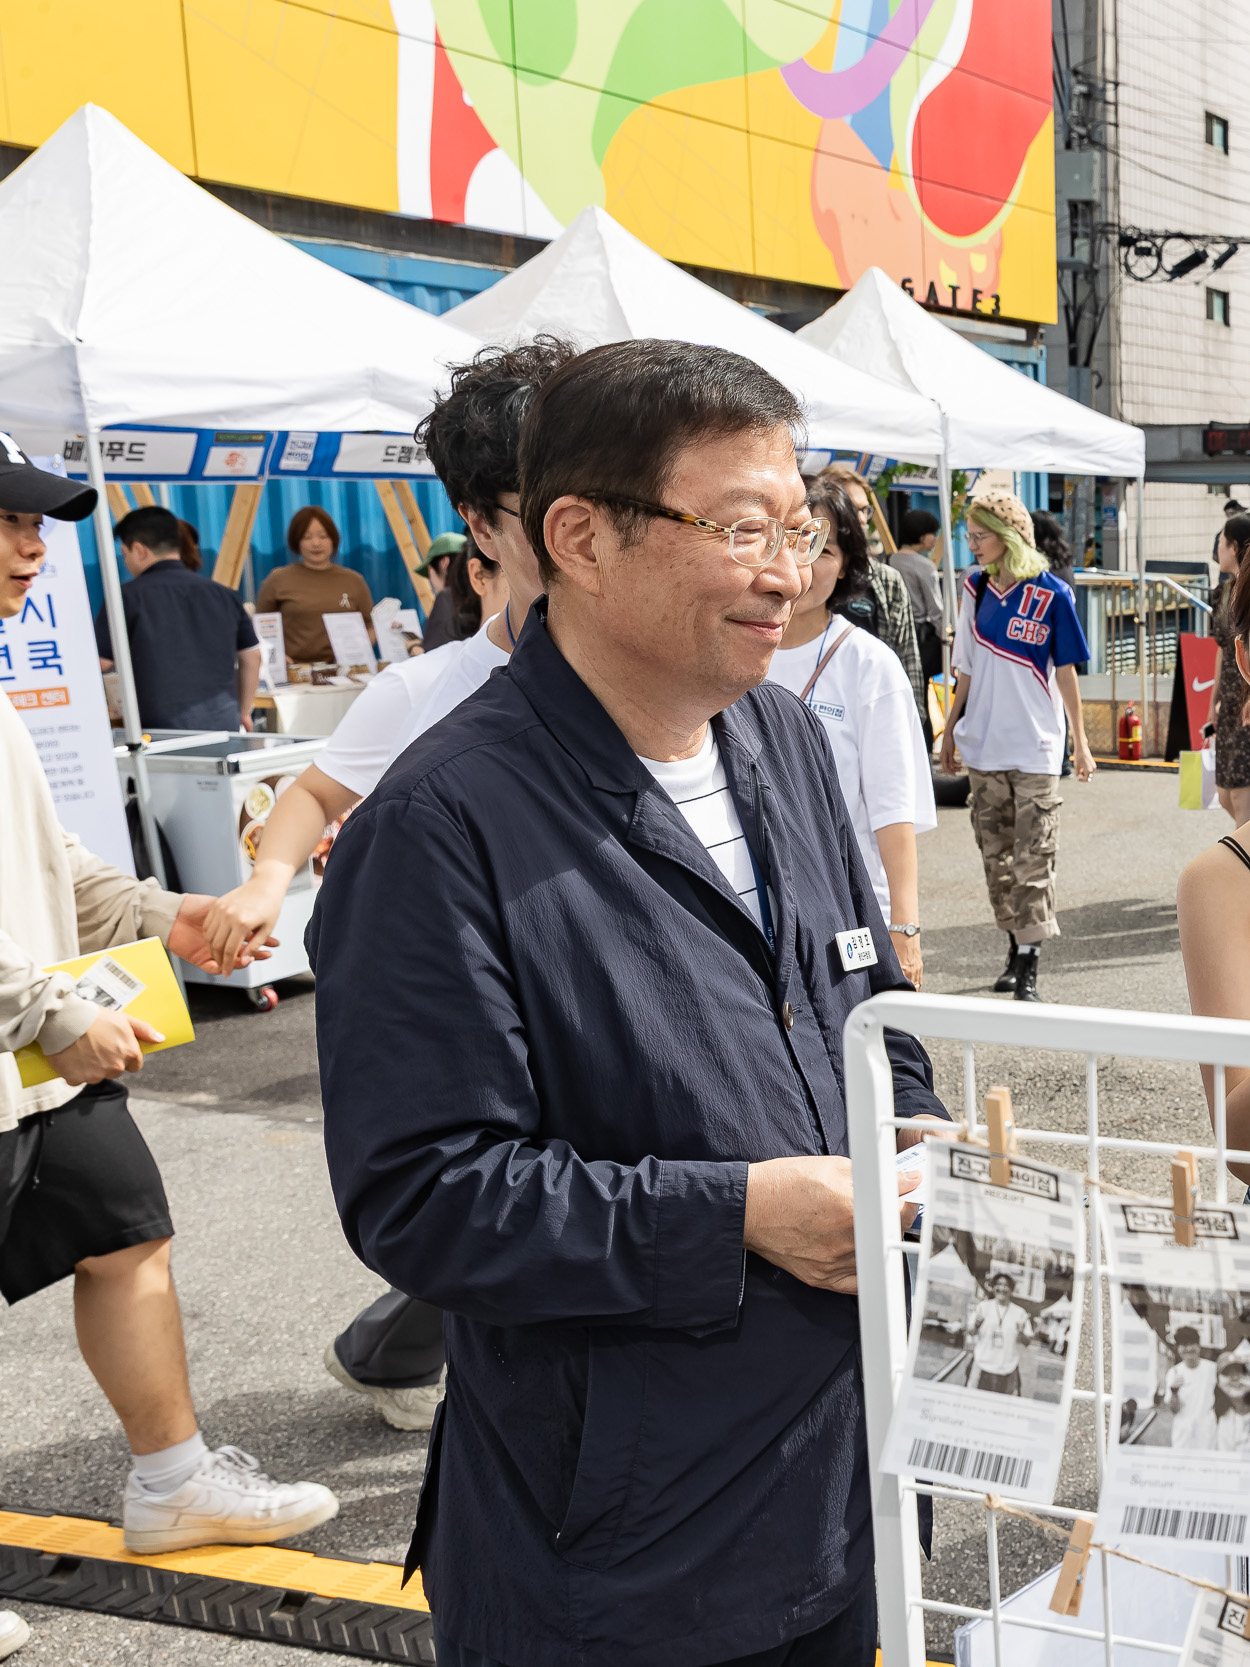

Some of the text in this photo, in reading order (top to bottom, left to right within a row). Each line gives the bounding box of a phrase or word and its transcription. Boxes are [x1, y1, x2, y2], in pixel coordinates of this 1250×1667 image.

[64, 438, 147, 462] 배푸드
[1017, 583, 1055, 621] 17
[1006, 617, 1050, 646] CHS
